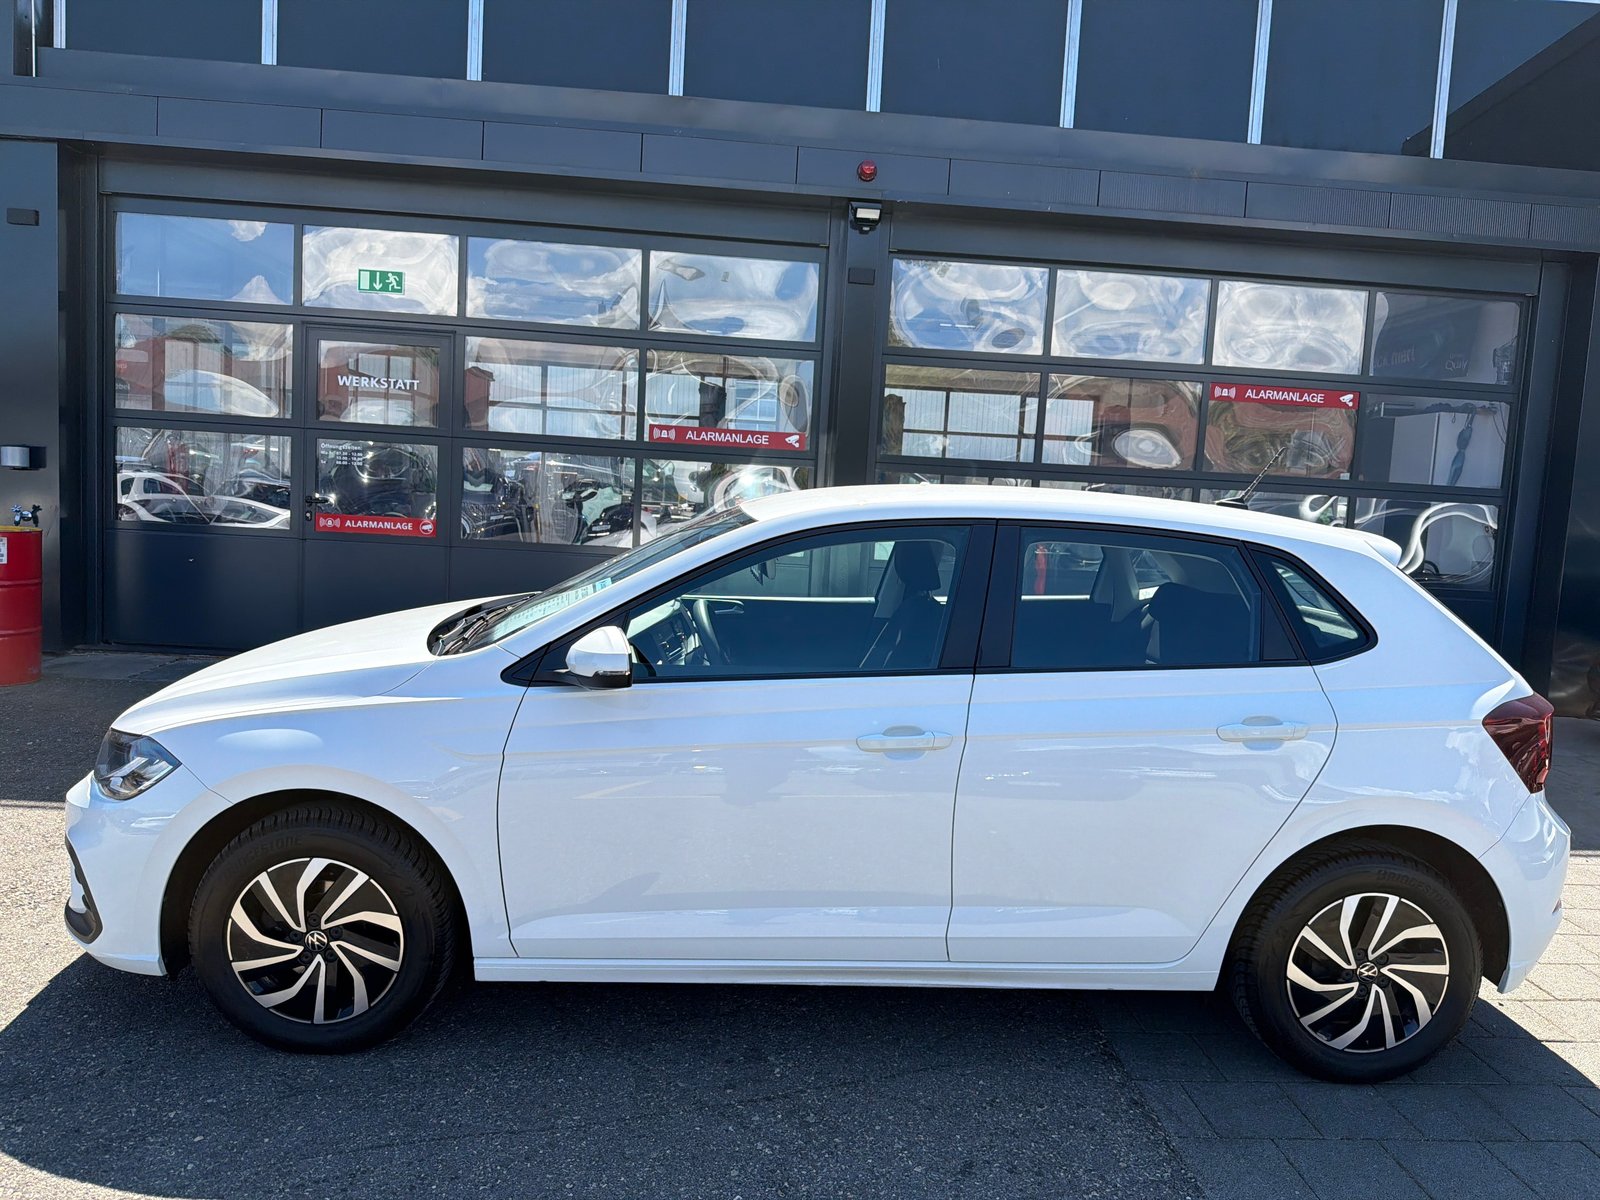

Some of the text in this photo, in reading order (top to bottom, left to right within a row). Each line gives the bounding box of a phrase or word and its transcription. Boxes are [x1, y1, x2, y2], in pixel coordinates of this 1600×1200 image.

[337, 375, 420, 391] WERKSTATT
[1244, 389, 1325, 404] ALARMANLAGE
[685, 430, 770, 445] ALARMANLAGE
[344, 519, 413, 531] ALARMANLAGE
